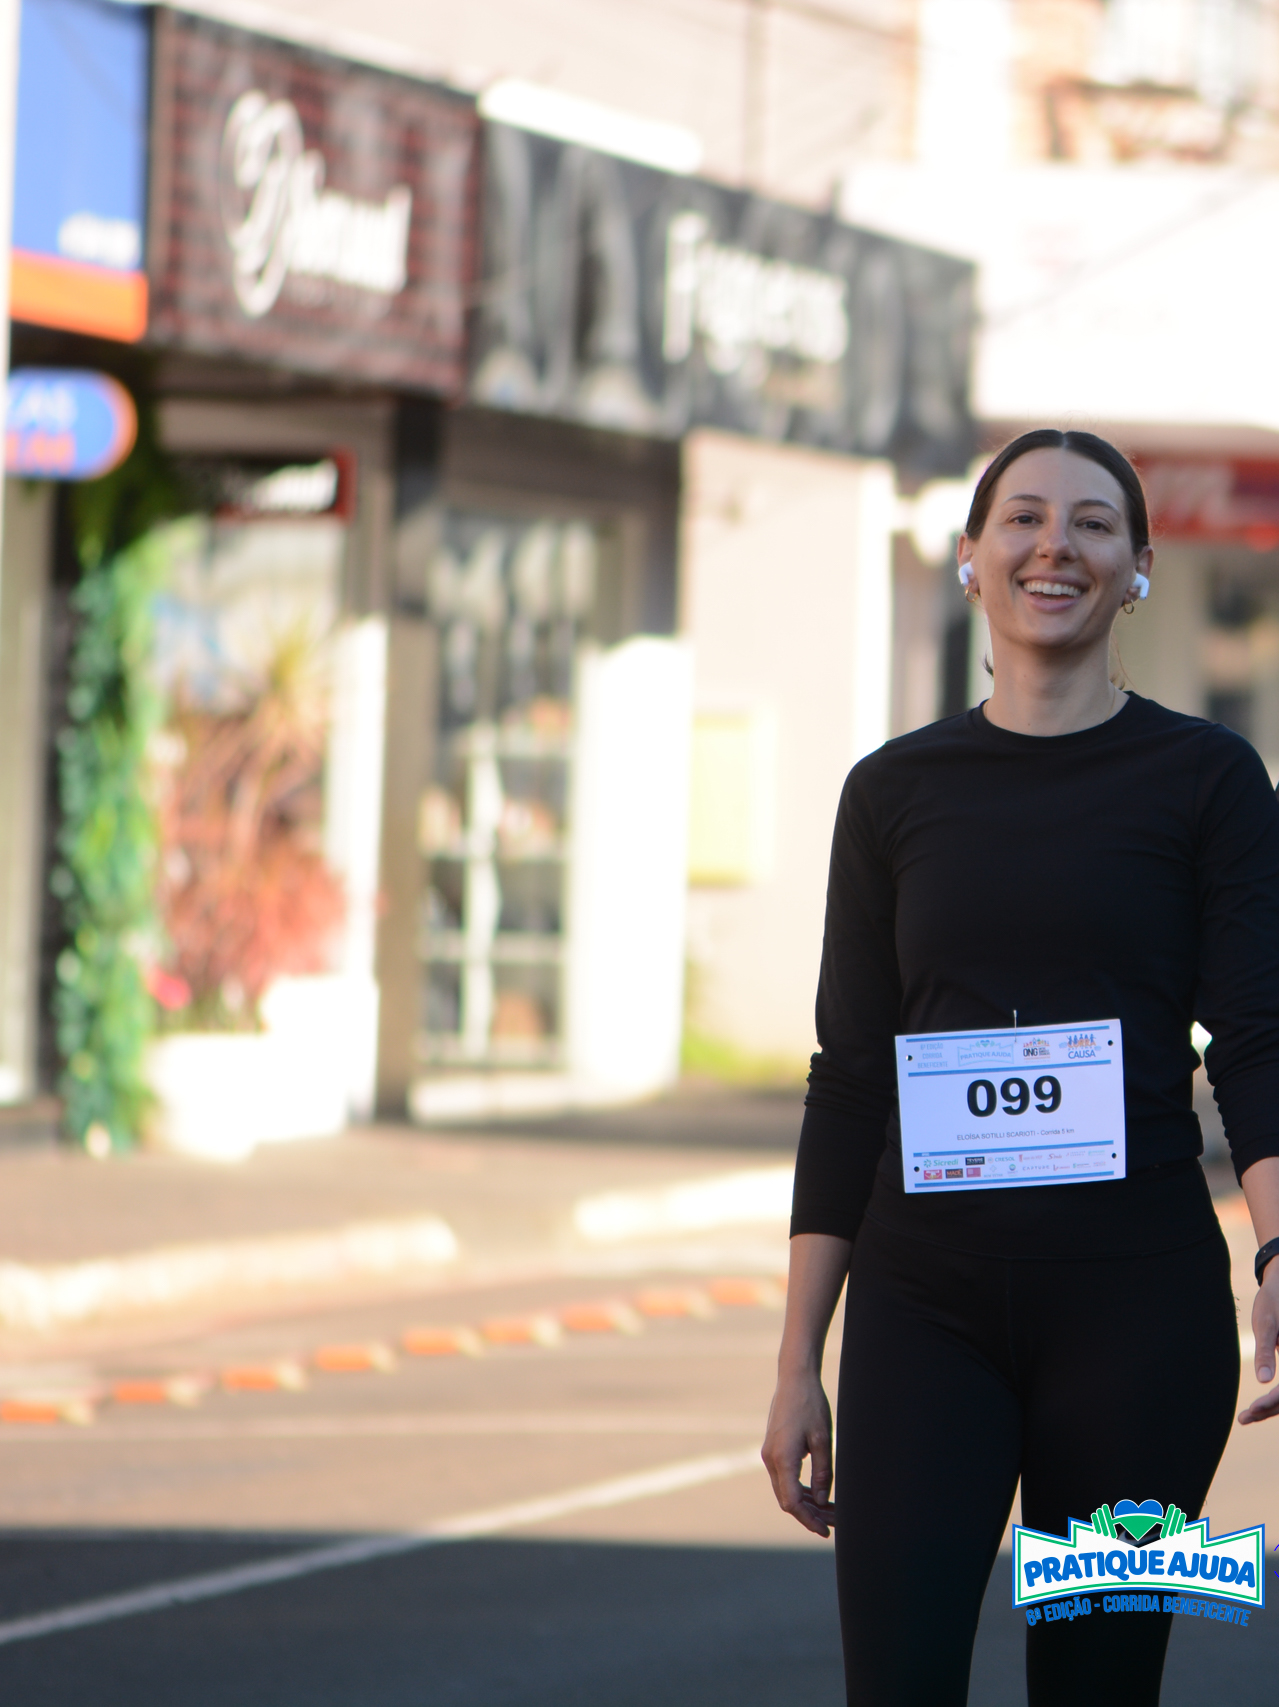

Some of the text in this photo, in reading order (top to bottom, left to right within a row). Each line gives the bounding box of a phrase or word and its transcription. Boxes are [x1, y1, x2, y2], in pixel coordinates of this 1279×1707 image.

[960, 1051, 990, 1060] PRATIQUE
[1023, 1048, 1038, 1057] ONG
[1067, 1049, 1096, 1059] CAUSA
[966, 1074, 1063, 1118] 099
[933, 1158, 959, 1167] Sicredi
